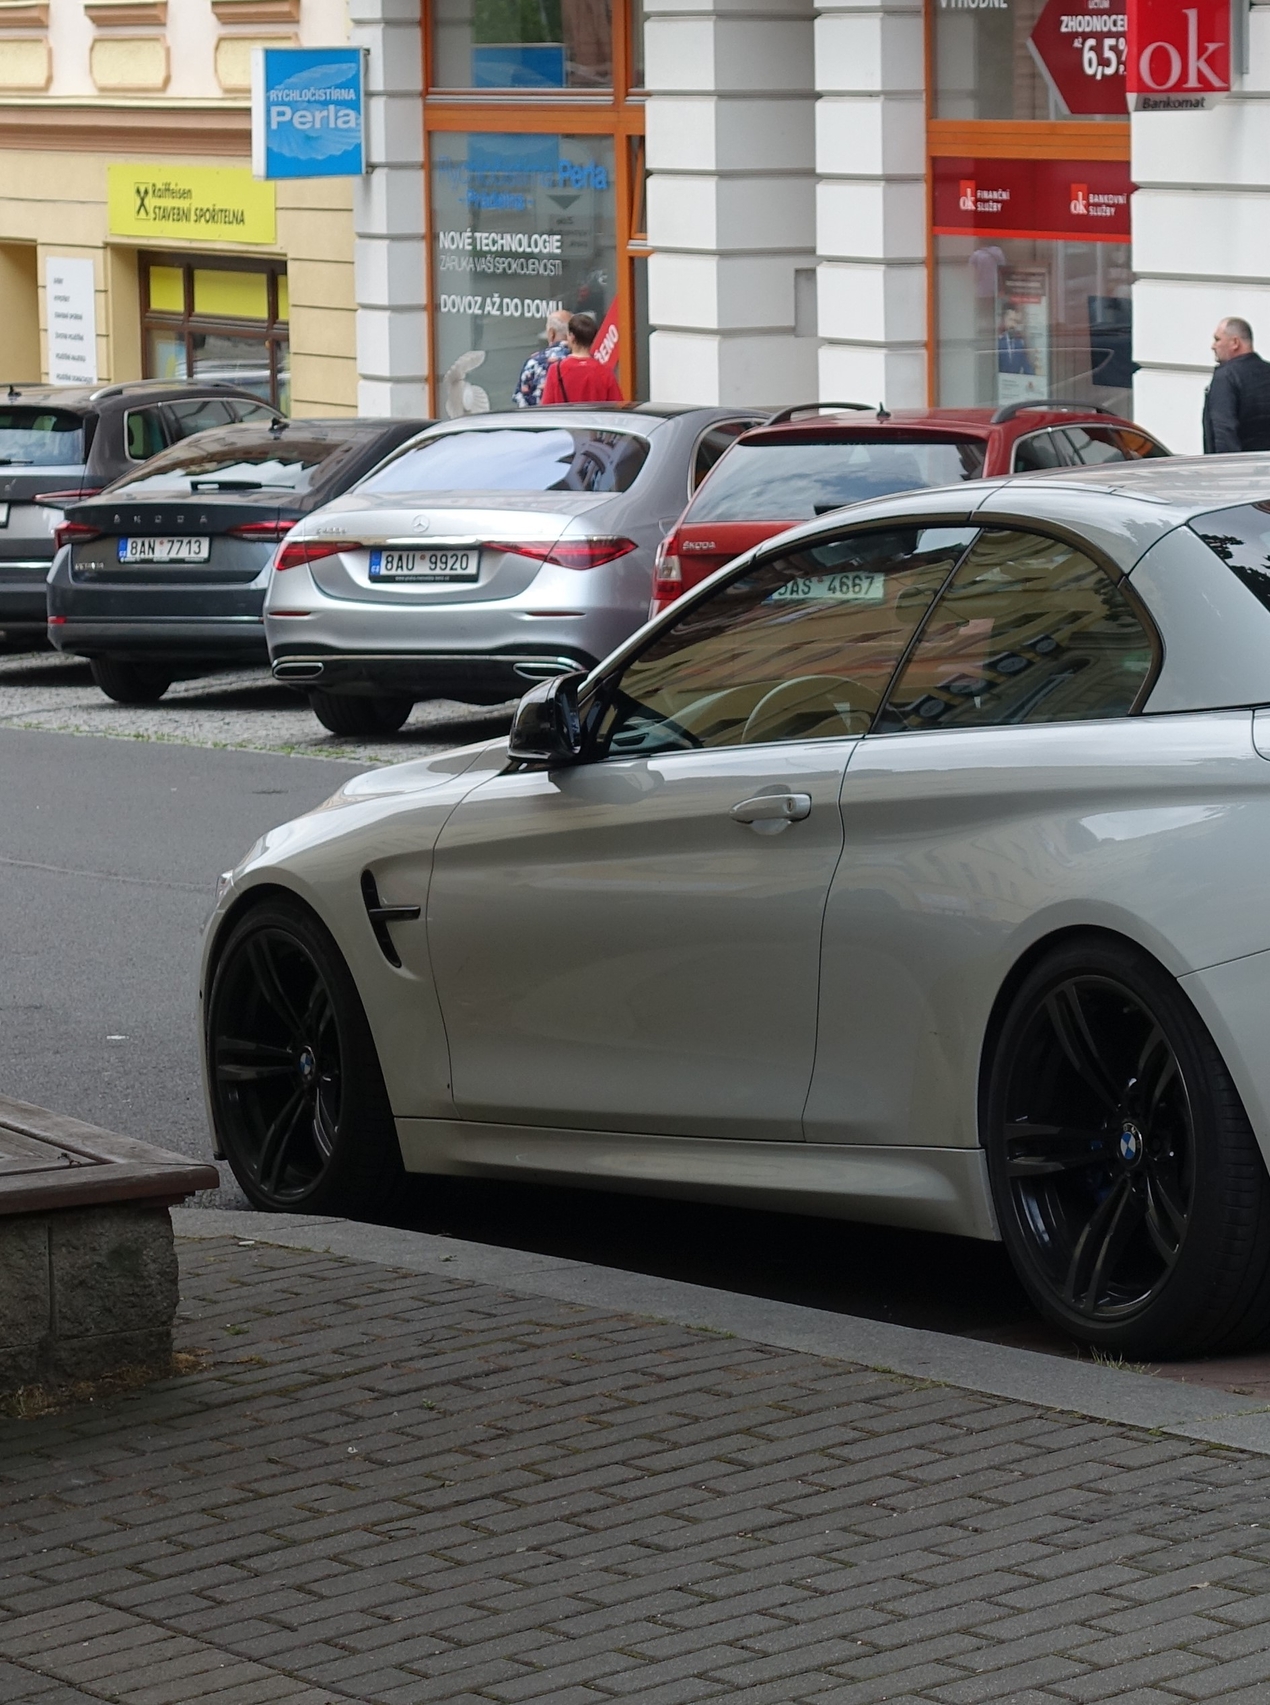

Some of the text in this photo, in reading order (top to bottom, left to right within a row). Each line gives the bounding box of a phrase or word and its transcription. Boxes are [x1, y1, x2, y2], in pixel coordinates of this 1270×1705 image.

[1139, 7, 1228, 90] ok
[270, 87, 356, 102] RYCHLOČISTÍRNA
[1143, 97, 1206, 109] Bankomat
[270, 104, 356, 130] Perla
[151, 183, 192, 200] Raiffeisen
[959, 188, 976, 211] ok
[977, 189, 1010, 200] FINANČNÍ
[1089, 193, 1127, 204] BANKOVNÍ
[977, 202, 1002, 212] SLUŽBY
[1070, 191, 1088, 215] ok
[1089, 205, 1115, 216] SLUŽBY
[152, 203, 245, 225] STAVEBNÍ SPOŘITELNA
[439, 228, 562, 253] NOVÉ TECHNOLOGIE
[440, 294, 482, 315] DOVOZ
[484, 292, 501, 316] AŽ
[503, 298, 522, 317] DO
[130, 539, 202, 556] 8AN 7713
[384, 553, 470, 572] 8AU 9920
[827, 574, 875, 595] 4667
